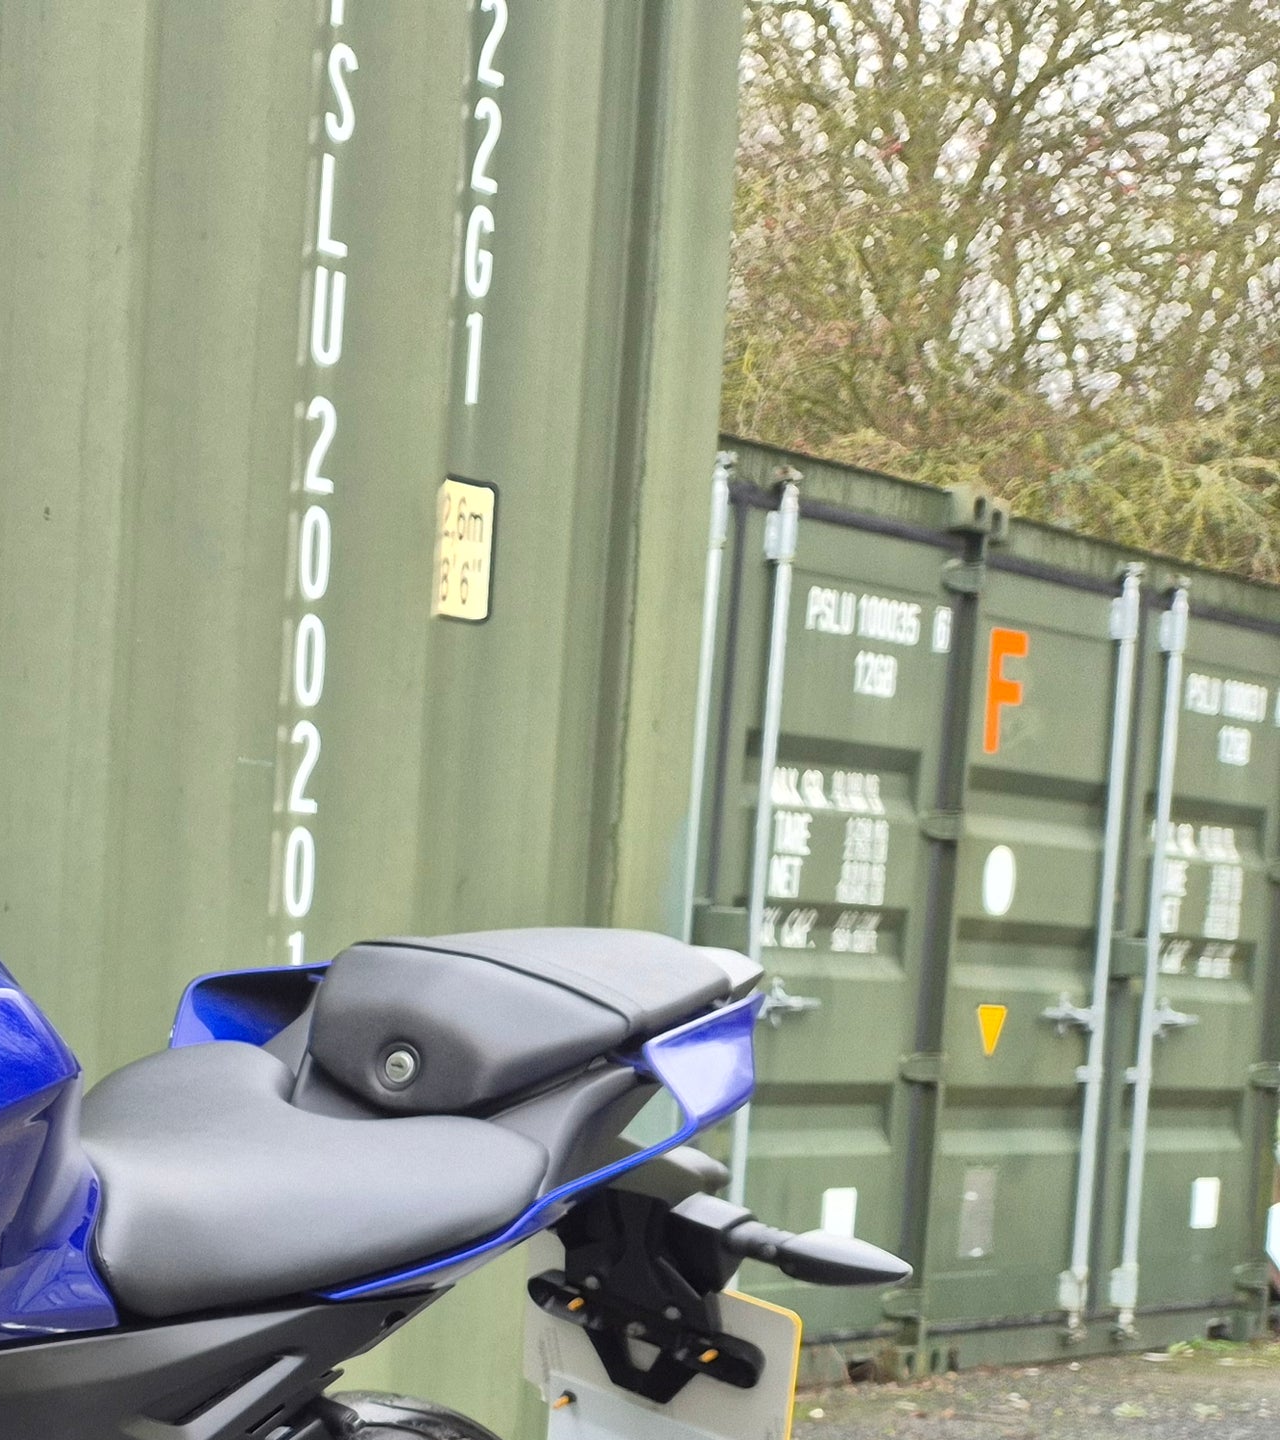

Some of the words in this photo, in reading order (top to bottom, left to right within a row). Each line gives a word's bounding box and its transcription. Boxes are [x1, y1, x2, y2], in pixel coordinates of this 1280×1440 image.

[311, 0, 359, 365] SLU
[464, 0, 508, 405] 22G1
[805, 586, 857, 636] PSLU
[983, 628, 1029, 753] F
